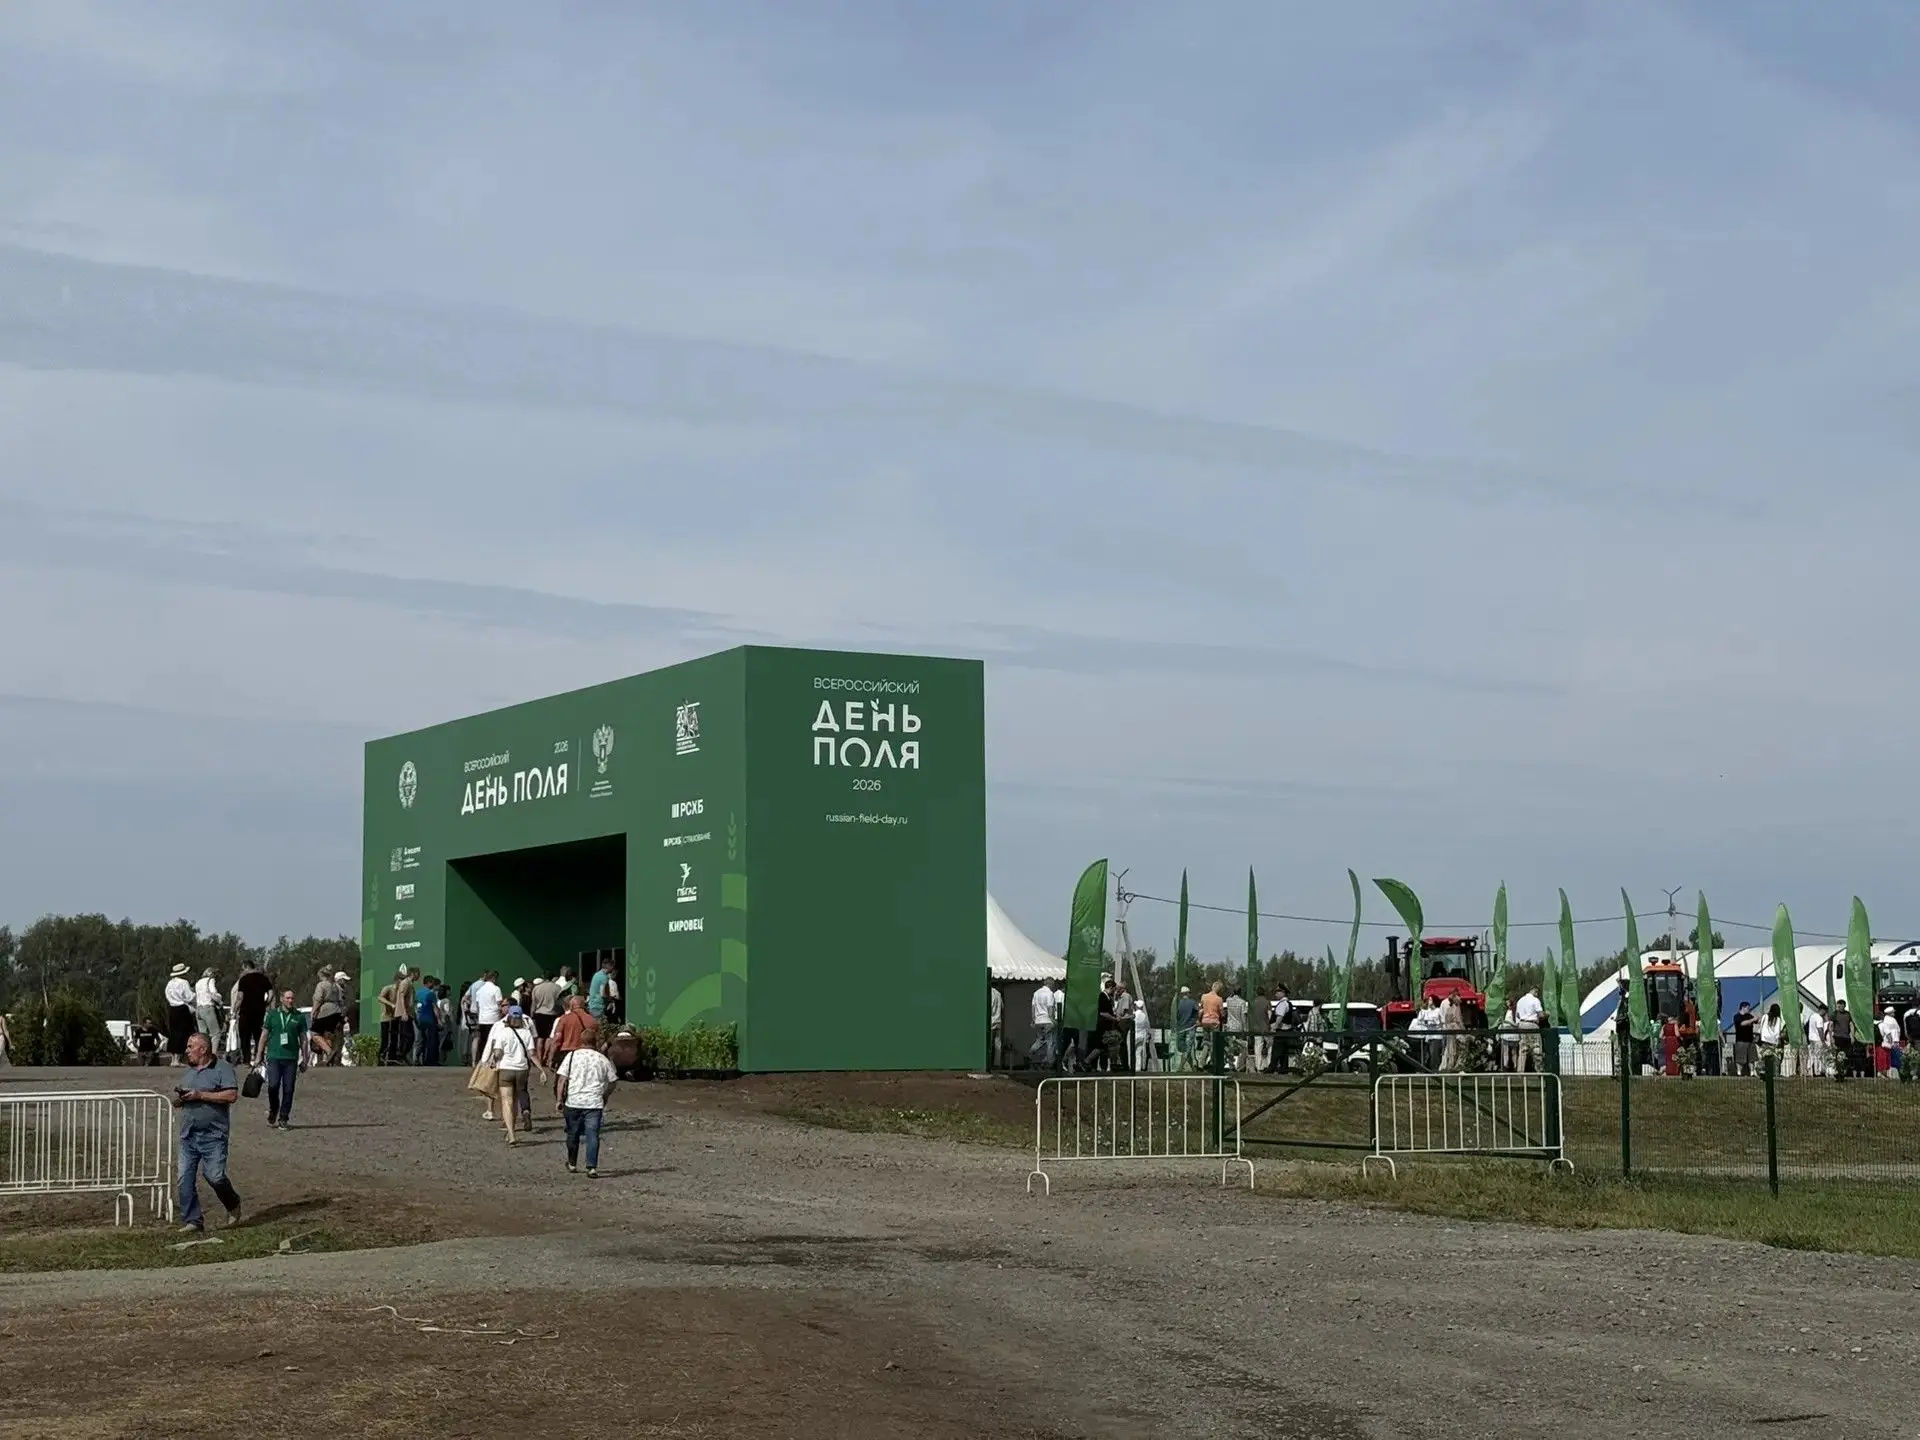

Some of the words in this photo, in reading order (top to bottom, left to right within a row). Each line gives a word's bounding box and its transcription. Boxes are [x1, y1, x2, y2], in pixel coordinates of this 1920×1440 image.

[813, 677, 920, 694] ВСЕРОССИЙСКИЙ
[811, 698, 922, 733] ДЕНЬ
[553, 740, 569, 754] 2026
[813, 736, 920, 769] ПОЛЯ
[460, 773, 508, 816] ДЕНЬ
[513, 763, 568, 803] ПОЛЯ
[852, 779, 882, 791] 2026
[680, 798, 704, 817] РСХБ
[825, 812, 908, 826] russian-field-day.ru
[668, 917, 704, 933] КИРОВЕЦ
